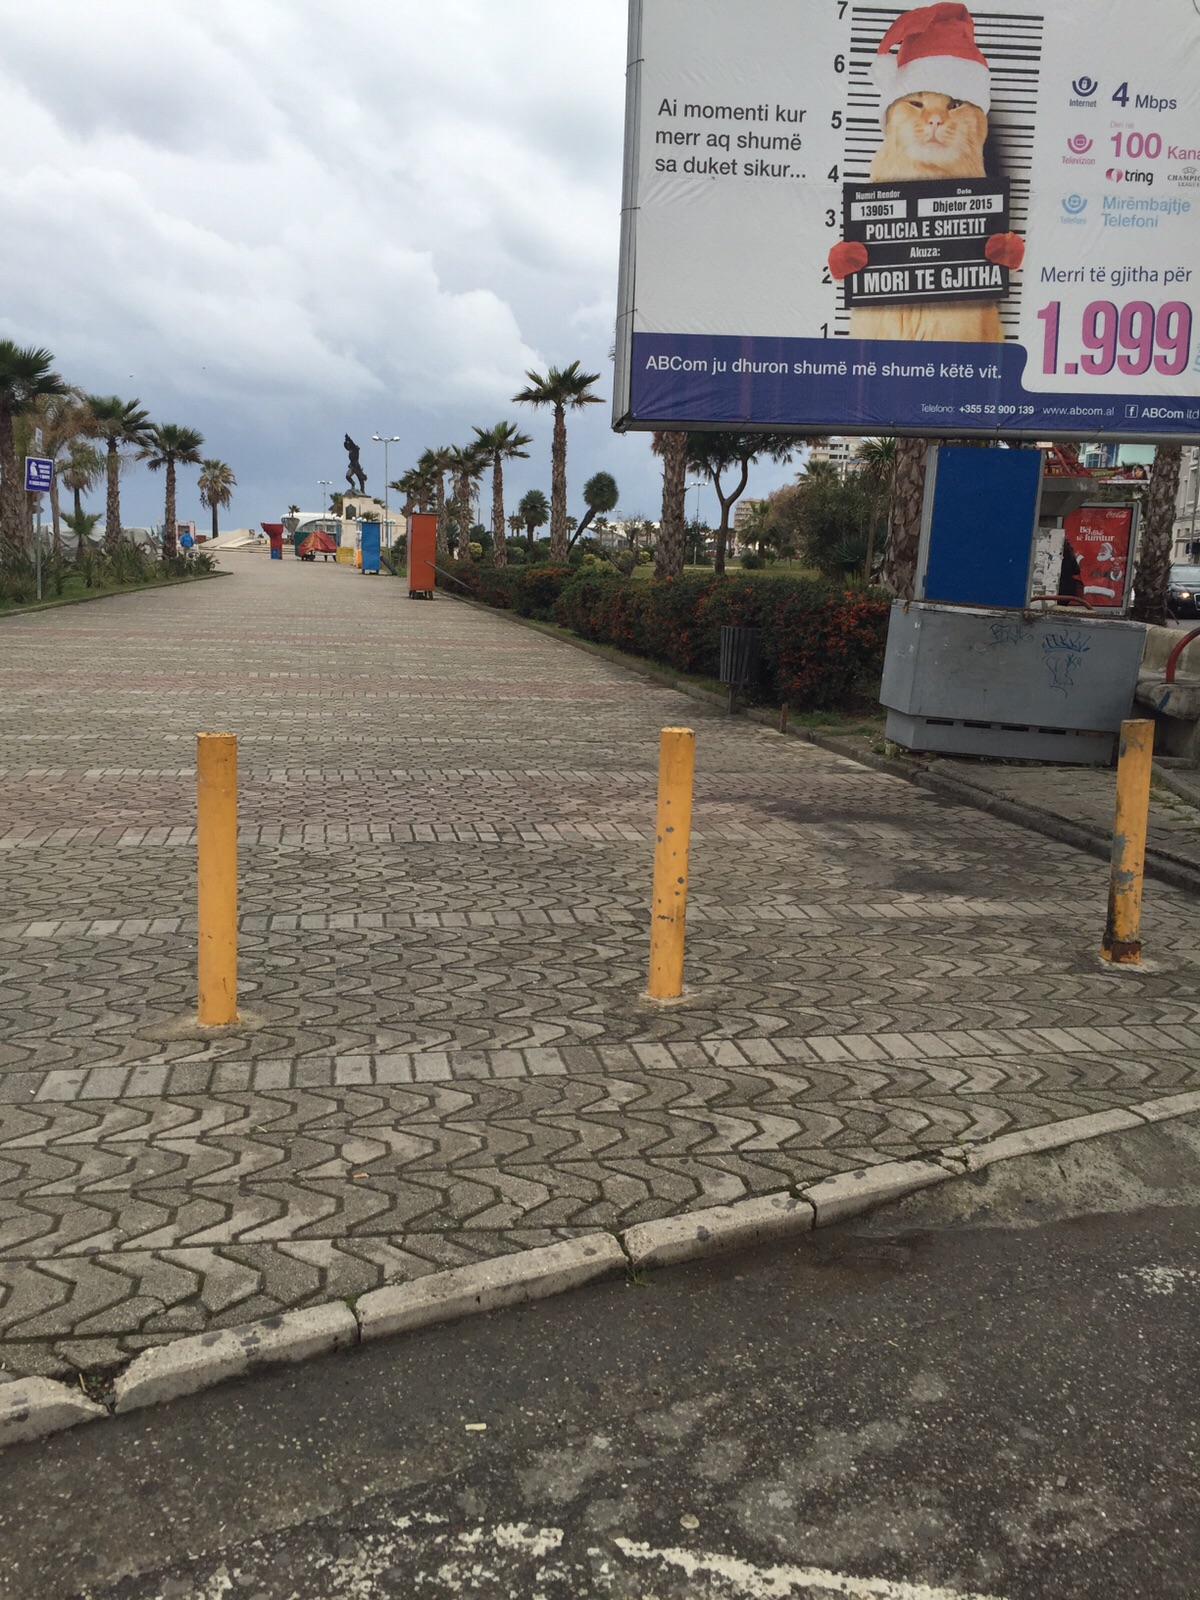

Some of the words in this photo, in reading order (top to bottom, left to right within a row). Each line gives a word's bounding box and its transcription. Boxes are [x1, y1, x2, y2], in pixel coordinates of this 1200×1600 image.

[837, 1, 848, 20] 7
[833, 54, 845, 73] 6
[1069, 99, 1097, 108] Internet
[1112, 82, 1130, 108] 4
[1135, 95, 1177, 112] Mbps
[658, 99, 677, 117] Ai
[684, 103, 769, 122] momenti
[775, 104, 807, 123] kur
[831, 111, 842, 130] 5
[655, 130, 701, 146] merr
[706, 134, 730, 151] aq
[737, 132, 802, 151] shumë
[1110, 132, 1162, 159] 100
[655, 158, 677, 173] sa
[683, 156, 738, 176] duket
[743, 160, 806, 178] sikur...
[1062, 156, 1095, 165] Televizion
[828, 165, 839, 182] 4
[1125, 169, 1153, 186] tring
[855, 191, 875, 200] Numri
[876, 190, 901, 199] Rendor
[860, 204, 894, 217] 139051
[932, 200, 967, 213] Dhjetor
[969, 198, 993, 211] 2015
[1102, 196, 1191, 215] Mirëmbajtje
[825, 209, 836, 228] 3
[1060, 216, 1087, 224] Telefoni
[1101, 213, 1159, 228] Telefoni
[866, 221, 919, 240] POLICIA
[922, 221, 930, 237] E
[934, 217, 987, 236] SHTETIT
[910, 246, 941, 258] Akuza:
[852, 273, 858, 294] I
[864, 270, 909, 294] MORI
[915, 268, 935, 290] TE
[941, 265, 1002, 289] GJITHA
[1040, 266, 1085, 283] Merri
[1090, 265, 1107, 283] të
[1110, 266, 1159, 287] gjitha
[1163, 267, 1193, 286] për
[820, 323, 828, 338] 1
[1037, 300, 1193, 376] 1.999
[645, 356, 708, 371] ABCom
[711, 358, 727, 375] ju
[732, 358, 789, 374] dhuron
[793, 360, 847, 375] shumë
[852, 361, 877, 376] më
[881, 362, 935, 377] shumë
[940, 363, 974, 378] këtë
[978, 365, 1002, 379] vit.
[921, 403, 955, 413] Telefono:
[959, 404, 982, 414] +355
[984, 404, 996, 414] 52
[998, 405, 1016, 415] 900
[1018, 405, 1034, 415] 139
[1043, 405, 1115, 416] www.abcom.al
[1141, 407, 1184, 419] ABCom
